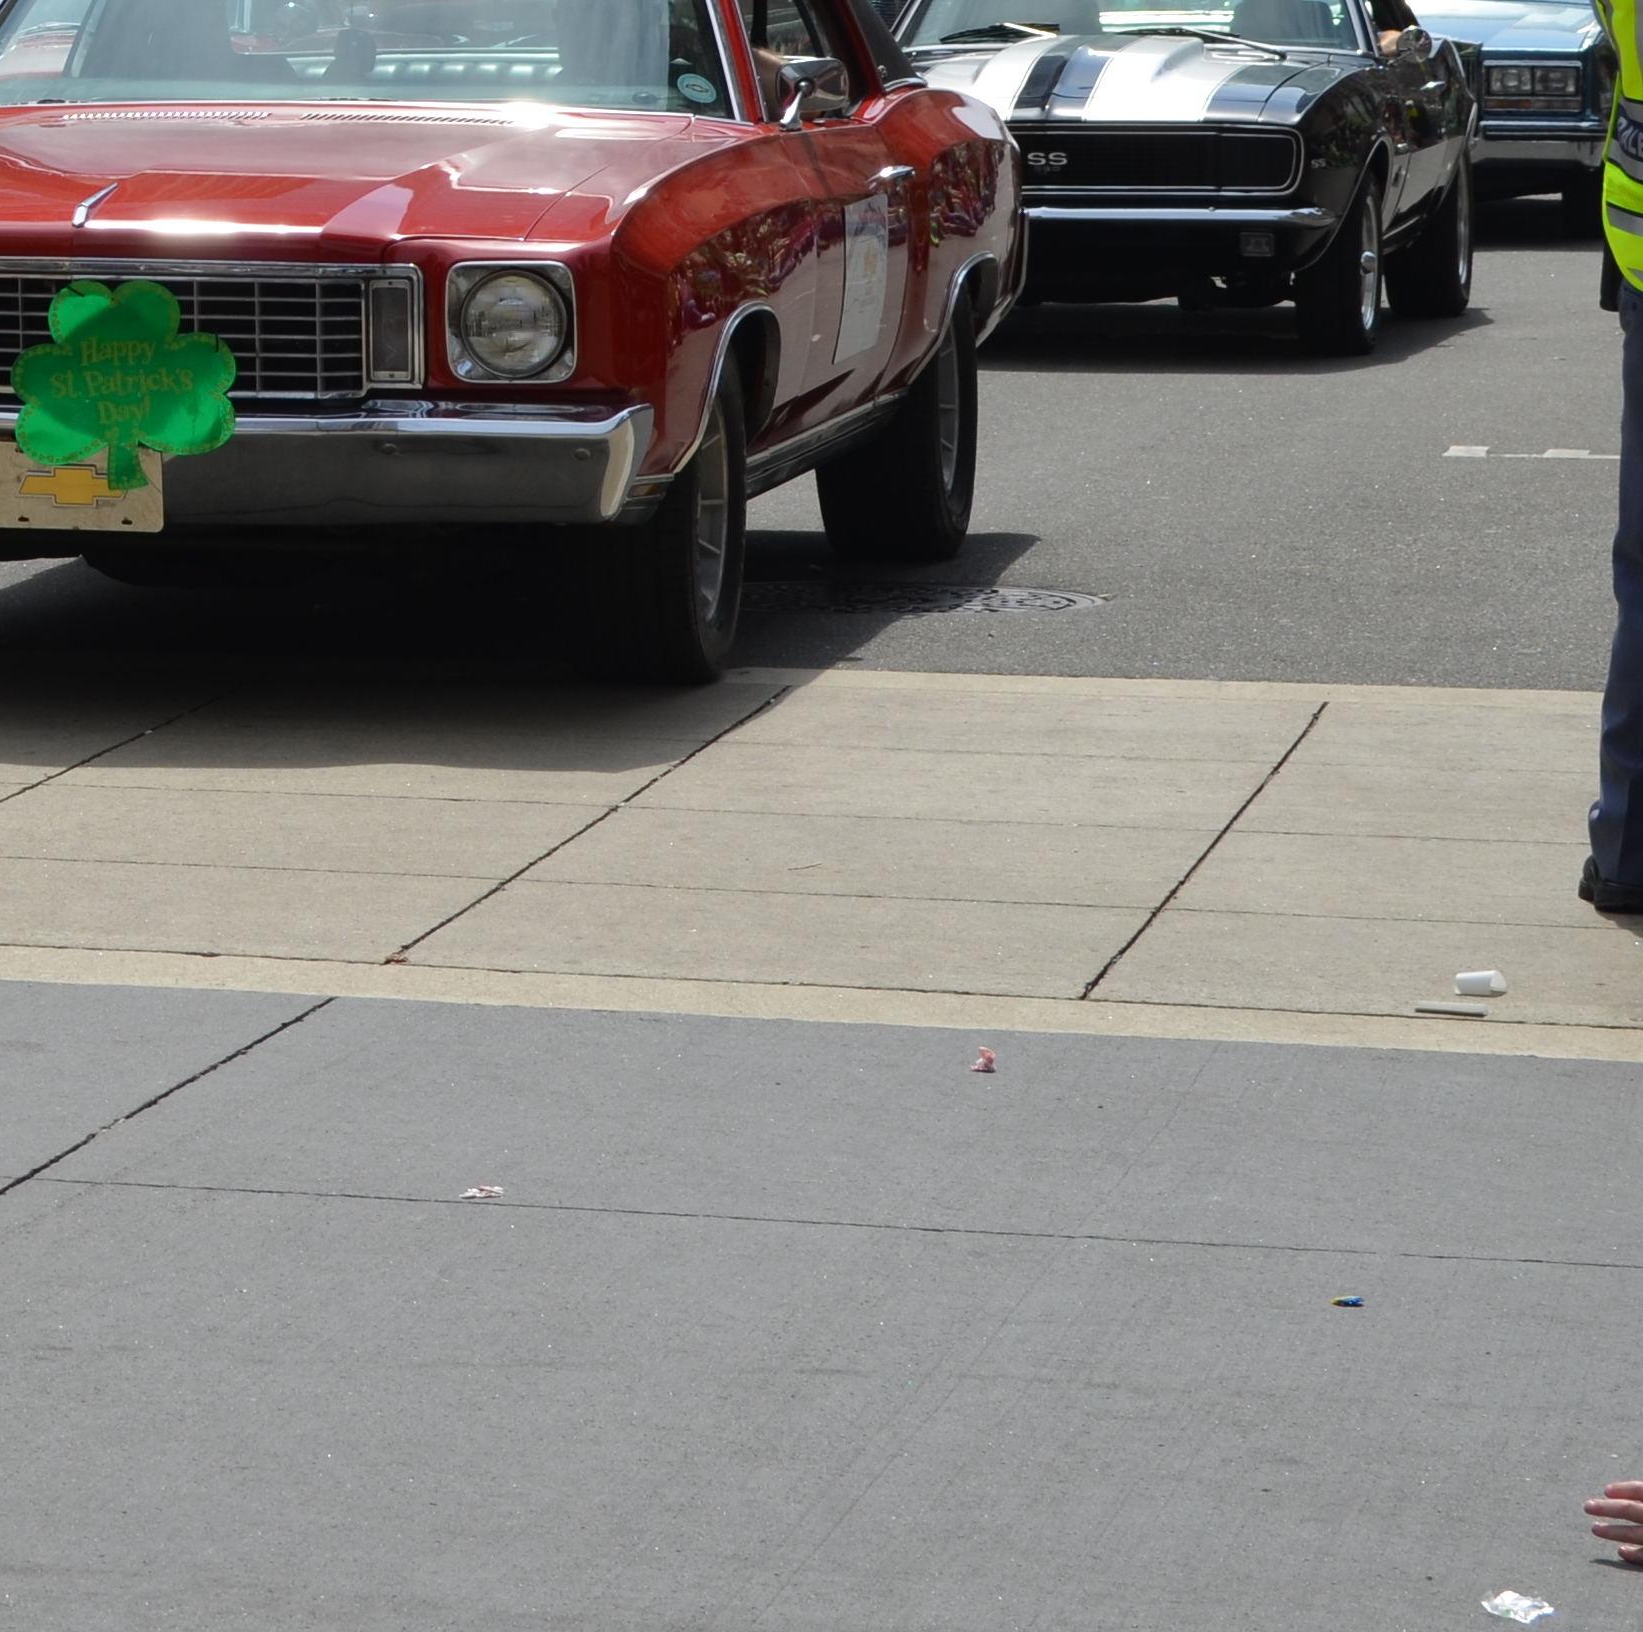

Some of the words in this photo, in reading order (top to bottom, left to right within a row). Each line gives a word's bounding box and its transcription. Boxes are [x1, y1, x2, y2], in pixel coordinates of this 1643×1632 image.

[1027, 151, 1068, 166] SS
[1311, 158, 1326, 169] SS
[80, 336, 156, 368] Happy
[84, 366, 194, 397] Patrick's
[97, 396, 151, 424] Day!
